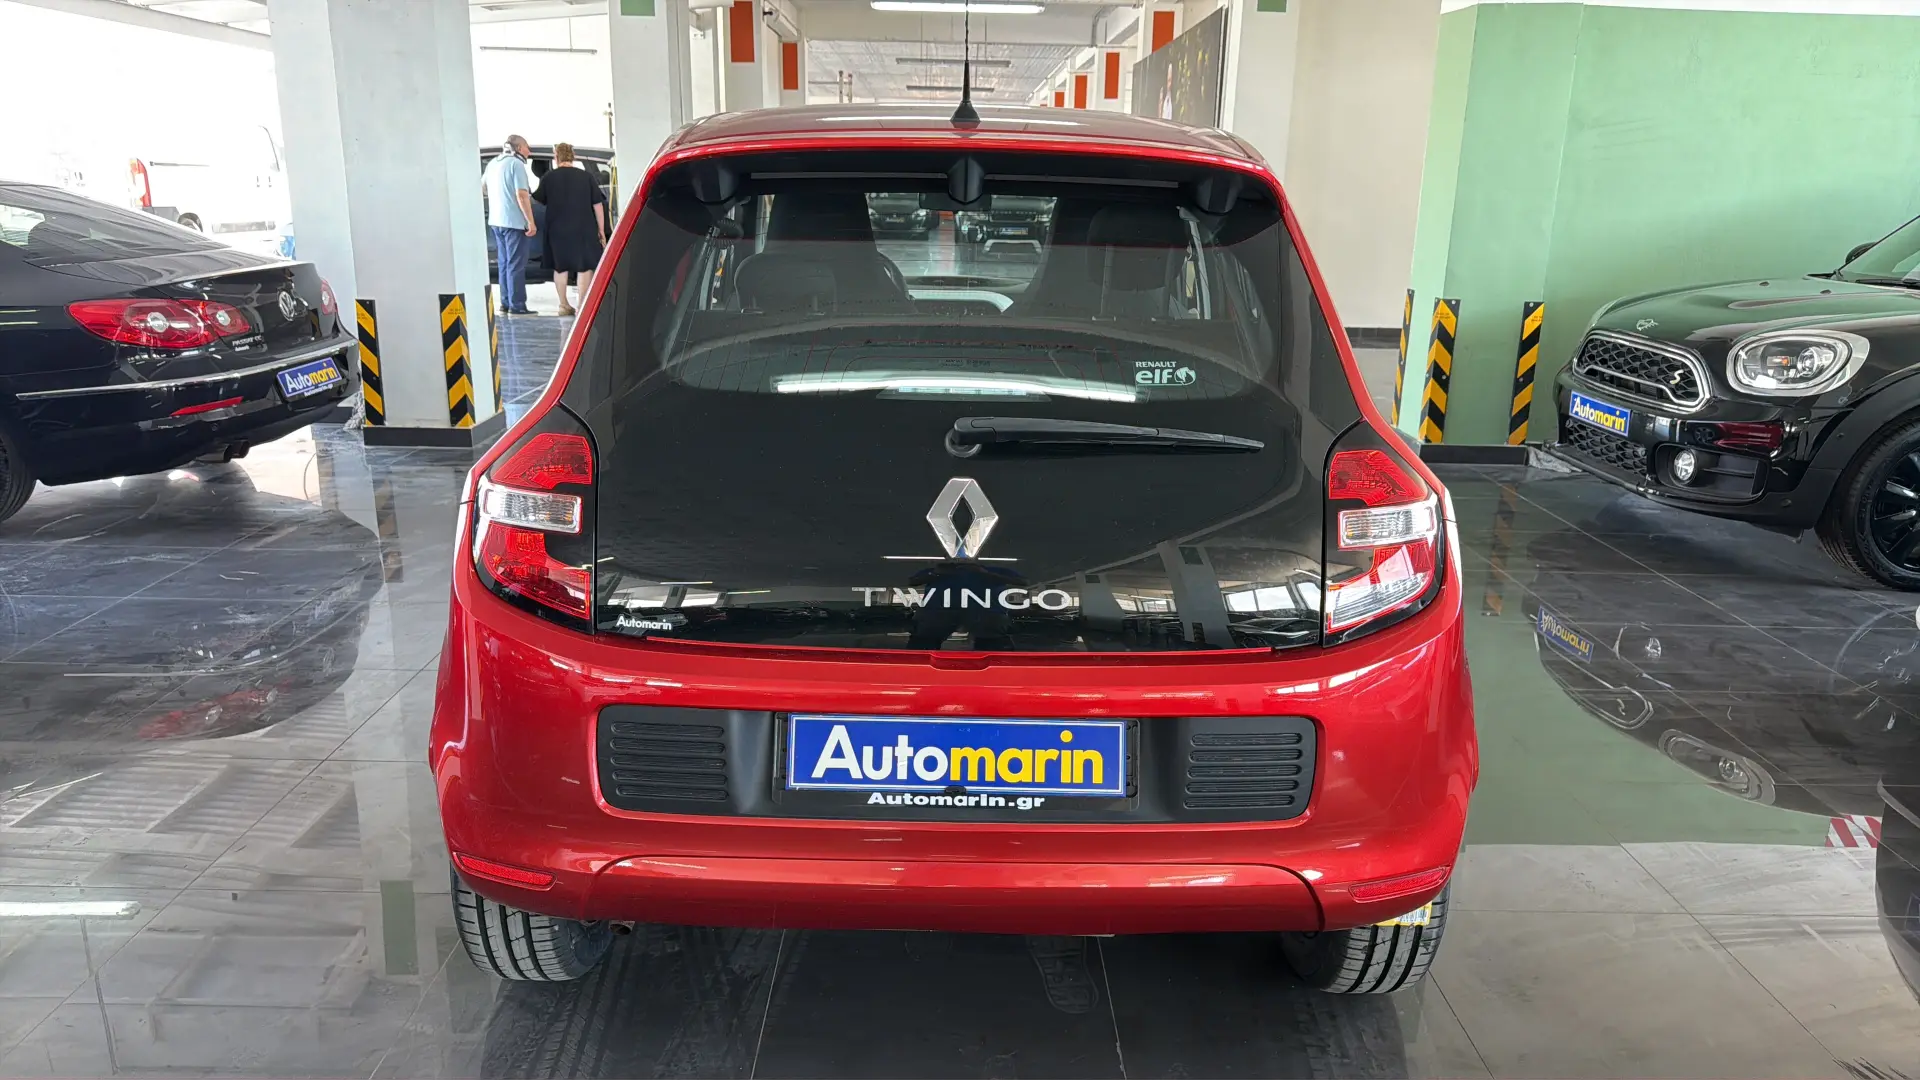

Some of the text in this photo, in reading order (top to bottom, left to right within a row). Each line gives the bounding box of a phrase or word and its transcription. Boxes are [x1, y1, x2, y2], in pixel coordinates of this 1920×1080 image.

[284, 361, 338, 393] Automarin
[1135, 369, 1174, 384] elf
[1572, 396, 1626, 432] Automarin
[851, 586, 1072, 611] TWINGO
[616, 613, 673, 631] Automarin
[811, 723, 1104, 784] Automarin
[867, 791, 1046, 810] Automarin.gr
